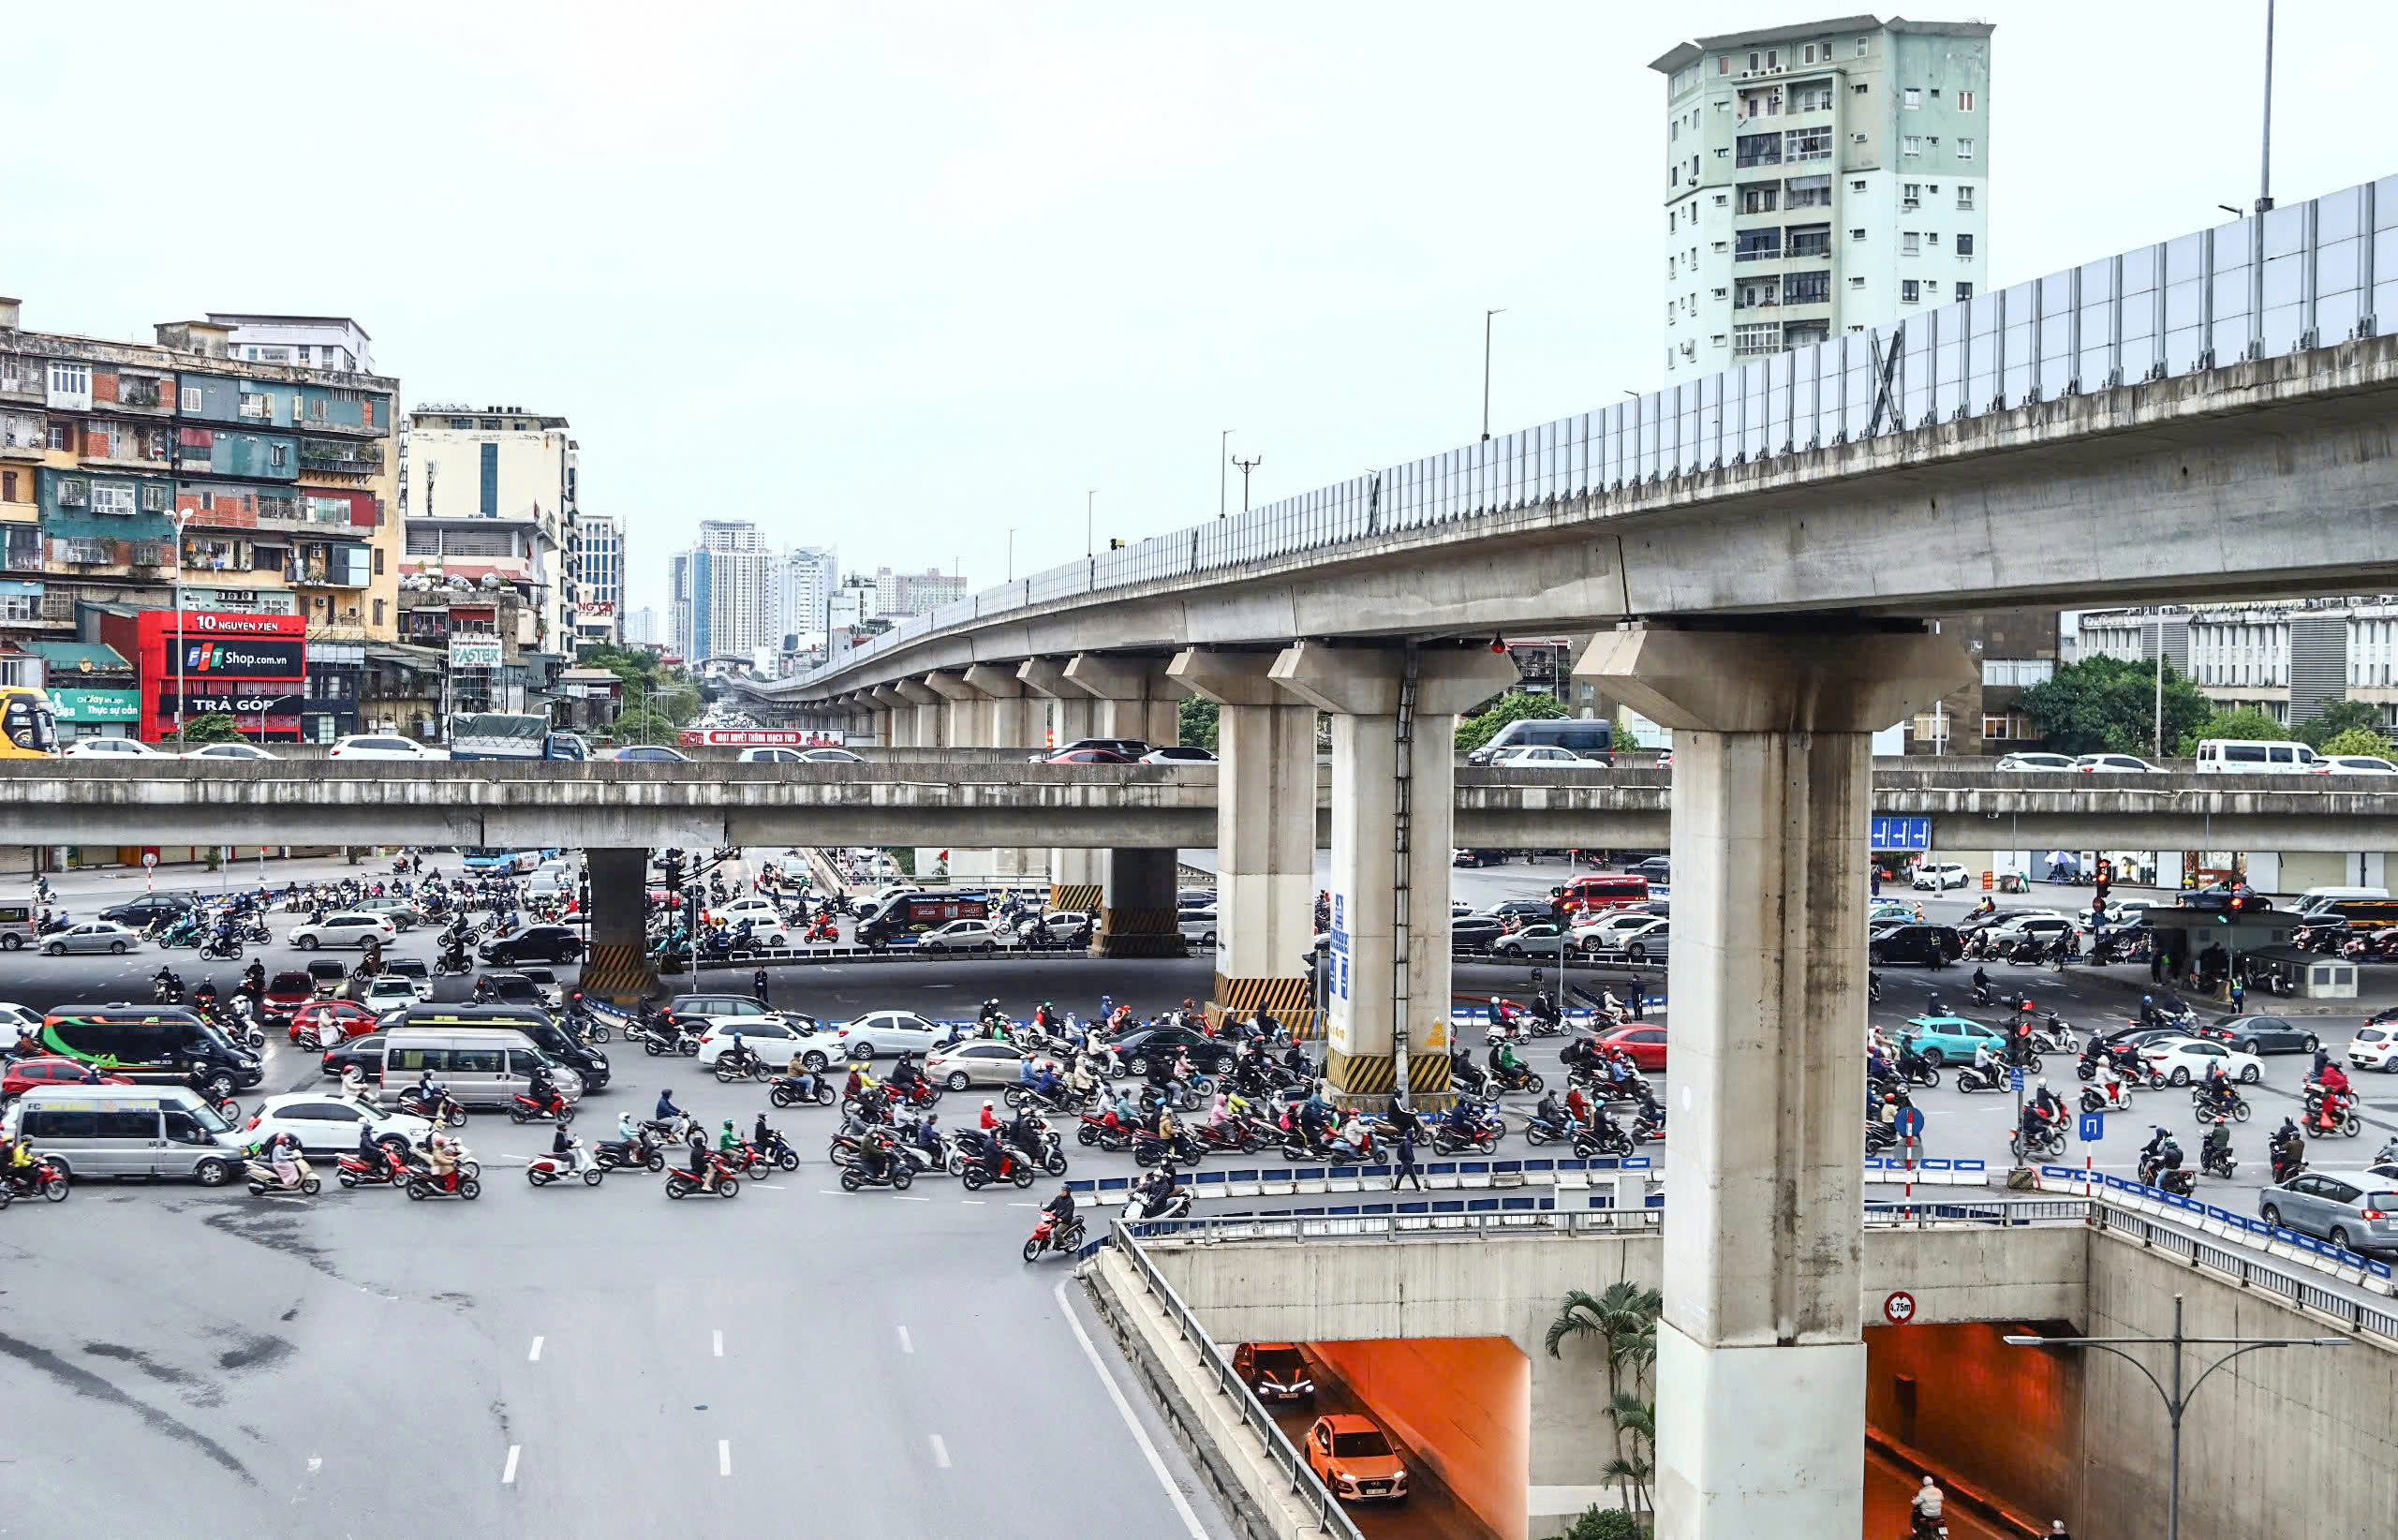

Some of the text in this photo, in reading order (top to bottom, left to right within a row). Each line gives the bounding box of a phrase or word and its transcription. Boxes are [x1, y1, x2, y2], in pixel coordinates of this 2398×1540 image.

[196, 615, 216, 630] 10
[225, 651, 288, 667] Shop.com.vn
[452, 647, 499, 662] FASTER
[192, 695, 274, 711] TRẢ GÓP
